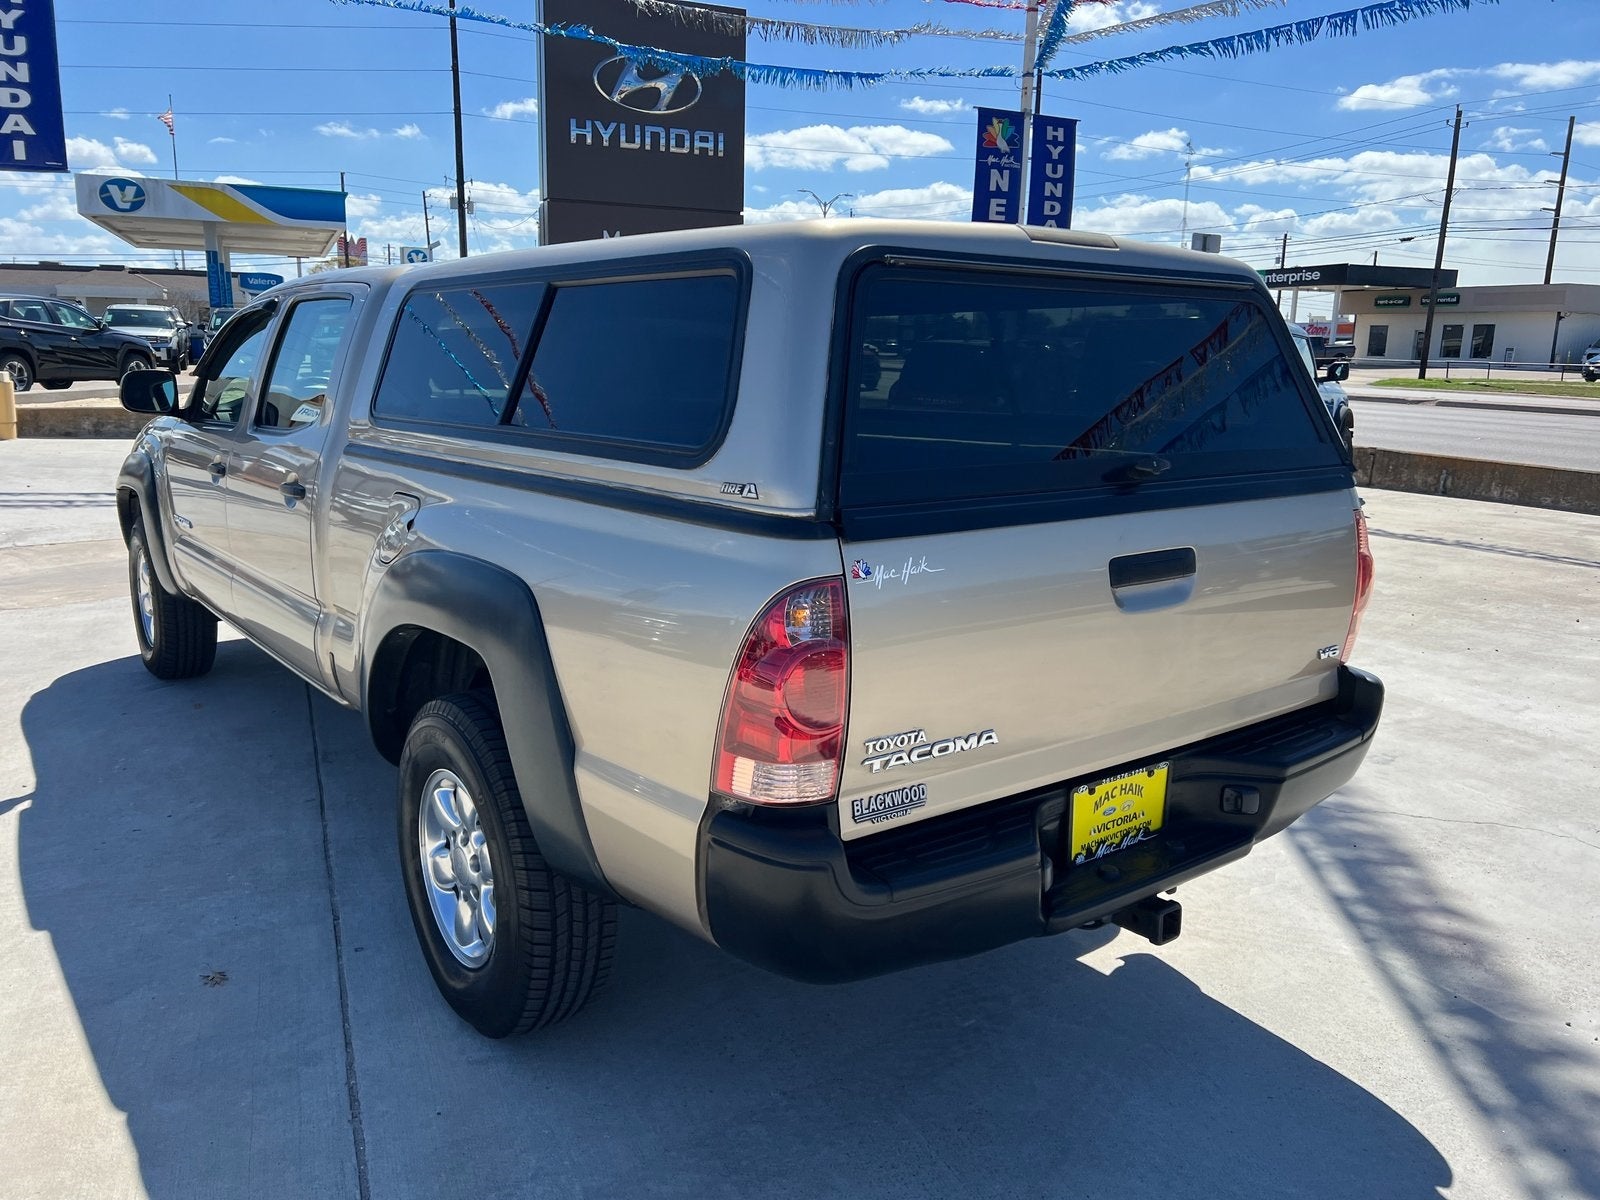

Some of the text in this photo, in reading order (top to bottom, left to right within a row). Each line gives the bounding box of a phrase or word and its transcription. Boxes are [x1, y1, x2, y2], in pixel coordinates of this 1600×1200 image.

[0, 0, 37, 161] YUNDAI
[569, 118, 724, 157] HYUNDAI
[988, 169, 1010, 221] NE
[247, 277, 277, 286] Valero
[864, 555, 938, 590] Mac Haik
[861, 728, 1000, 775] TACOMA
[864, 728, 927, 756] TOYOTA
[852, 783, 928, 818] BLACKWOOD
[1093, 783, 1144, 814] MAC HAIK
[871, 807, 912, 824] VICTORIA
[1096, 811, 1138, 834] VICTORIA
[1090, 829, 1151, 860] Mac Haik
